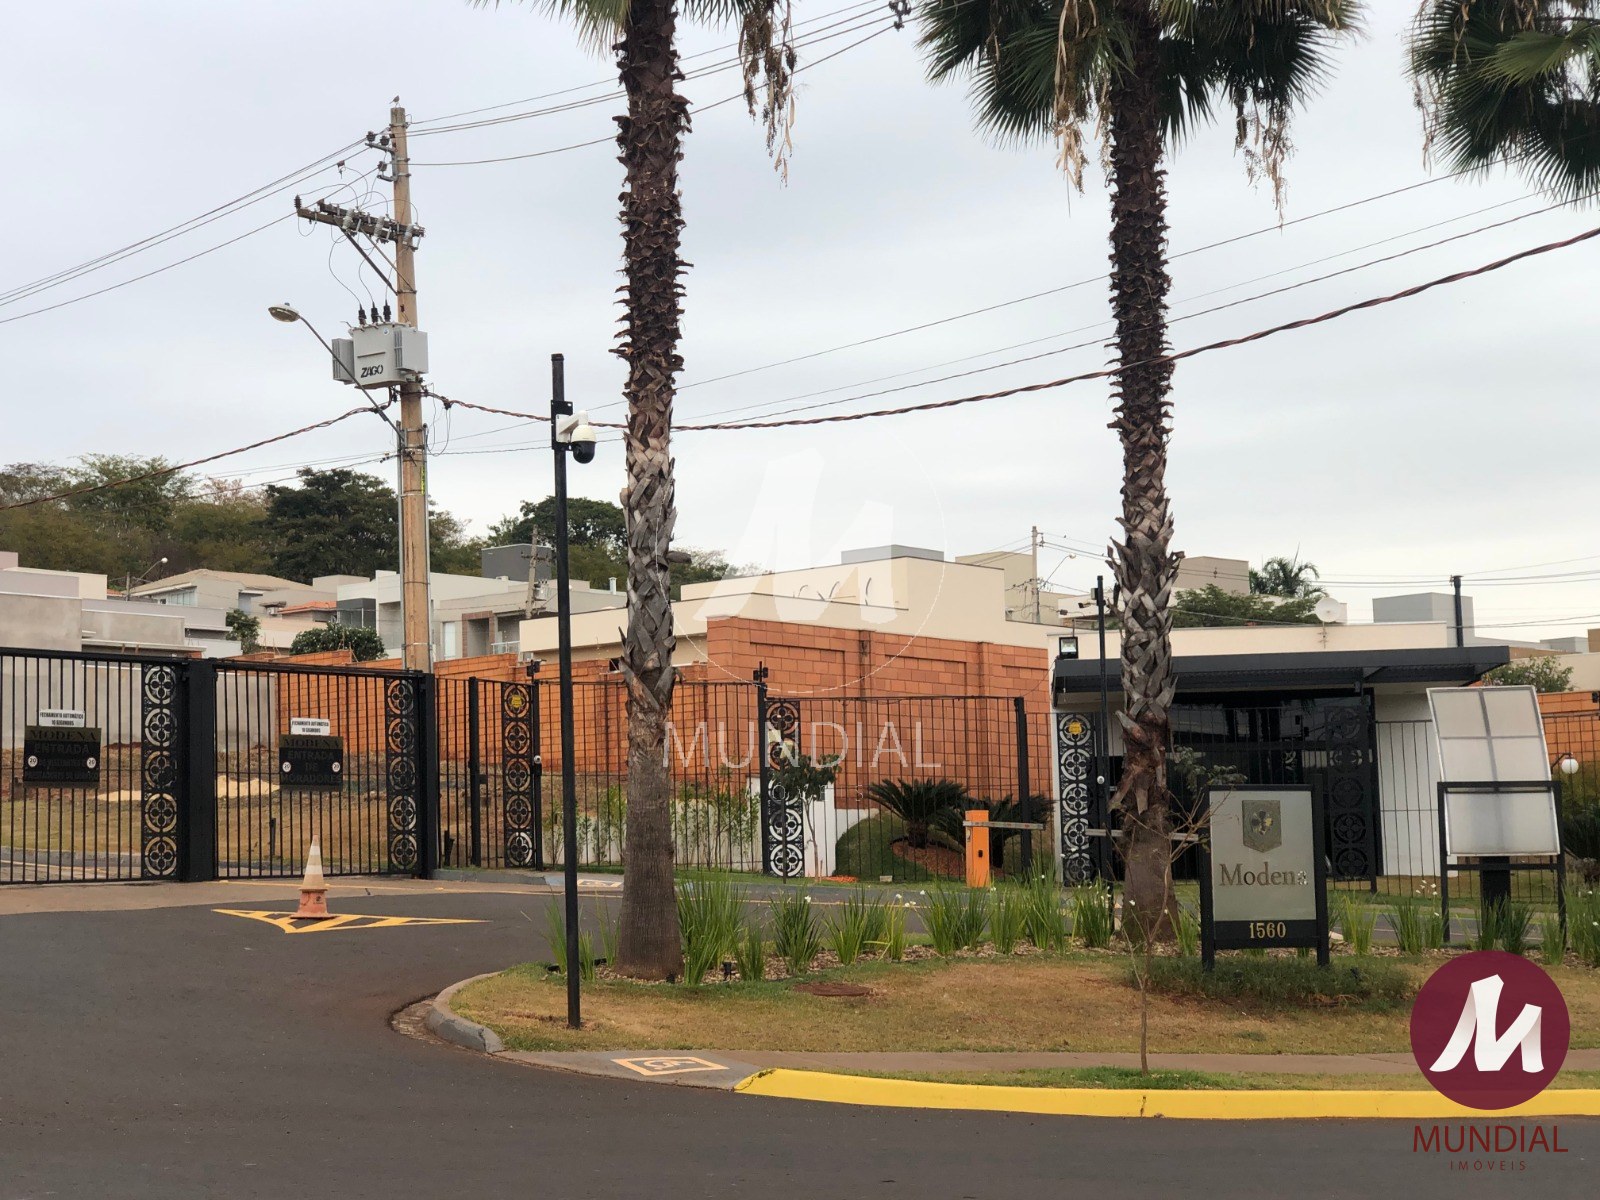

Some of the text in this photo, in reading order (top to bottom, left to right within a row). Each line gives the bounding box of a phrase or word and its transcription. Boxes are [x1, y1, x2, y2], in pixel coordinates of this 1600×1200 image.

[361, 365, 383, 378] ZAGO
[30, 730, 97, 741] MODENA
[287, 750, 335, 761] ENTRADA
[1219, 861, 1309, 887] Modena
[1249, 922, 1287, 939] 1560
